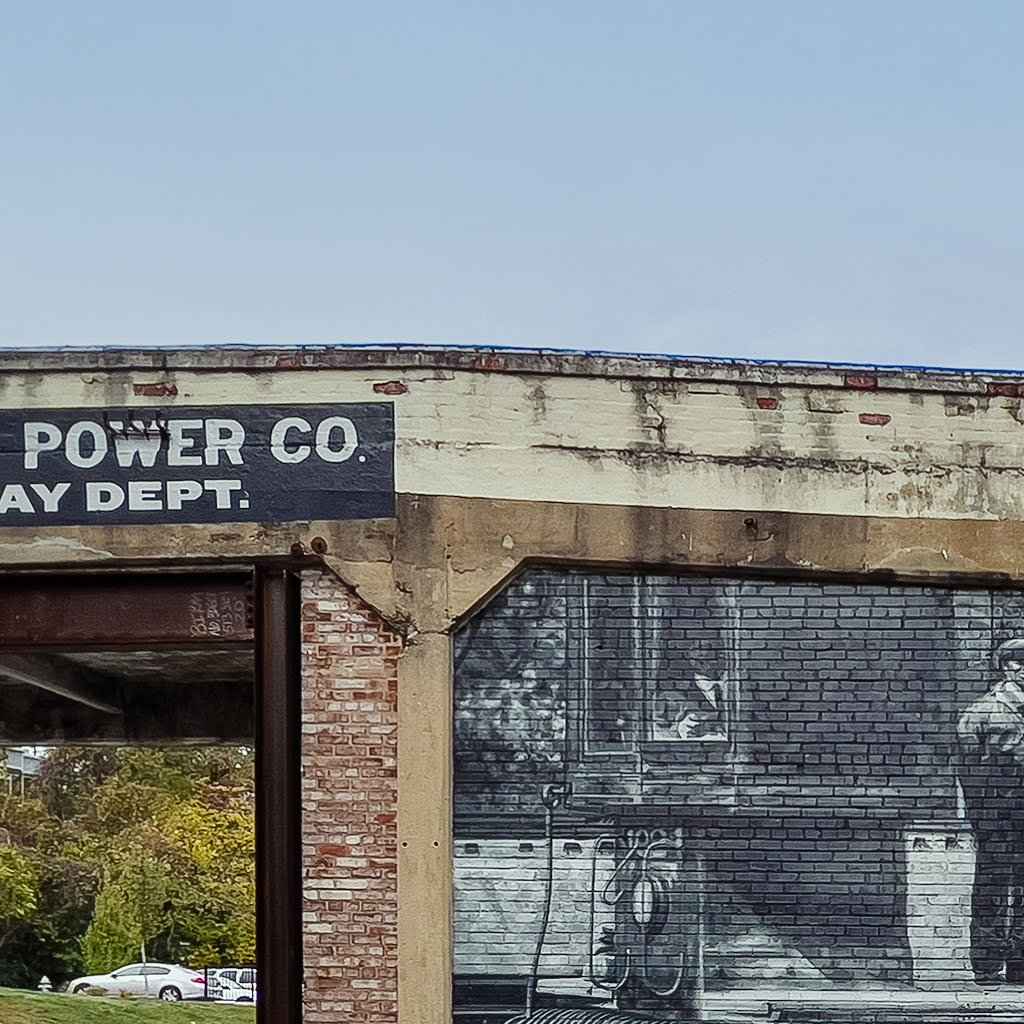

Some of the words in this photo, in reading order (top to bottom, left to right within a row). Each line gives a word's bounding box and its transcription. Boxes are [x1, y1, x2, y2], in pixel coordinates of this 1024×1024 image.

[24, 419, 245, 469] POWER
[271, 416, 365, 463] CO.
[0, 483, 71, 513] AY
[86, 480, 249, 511] DEPT.
